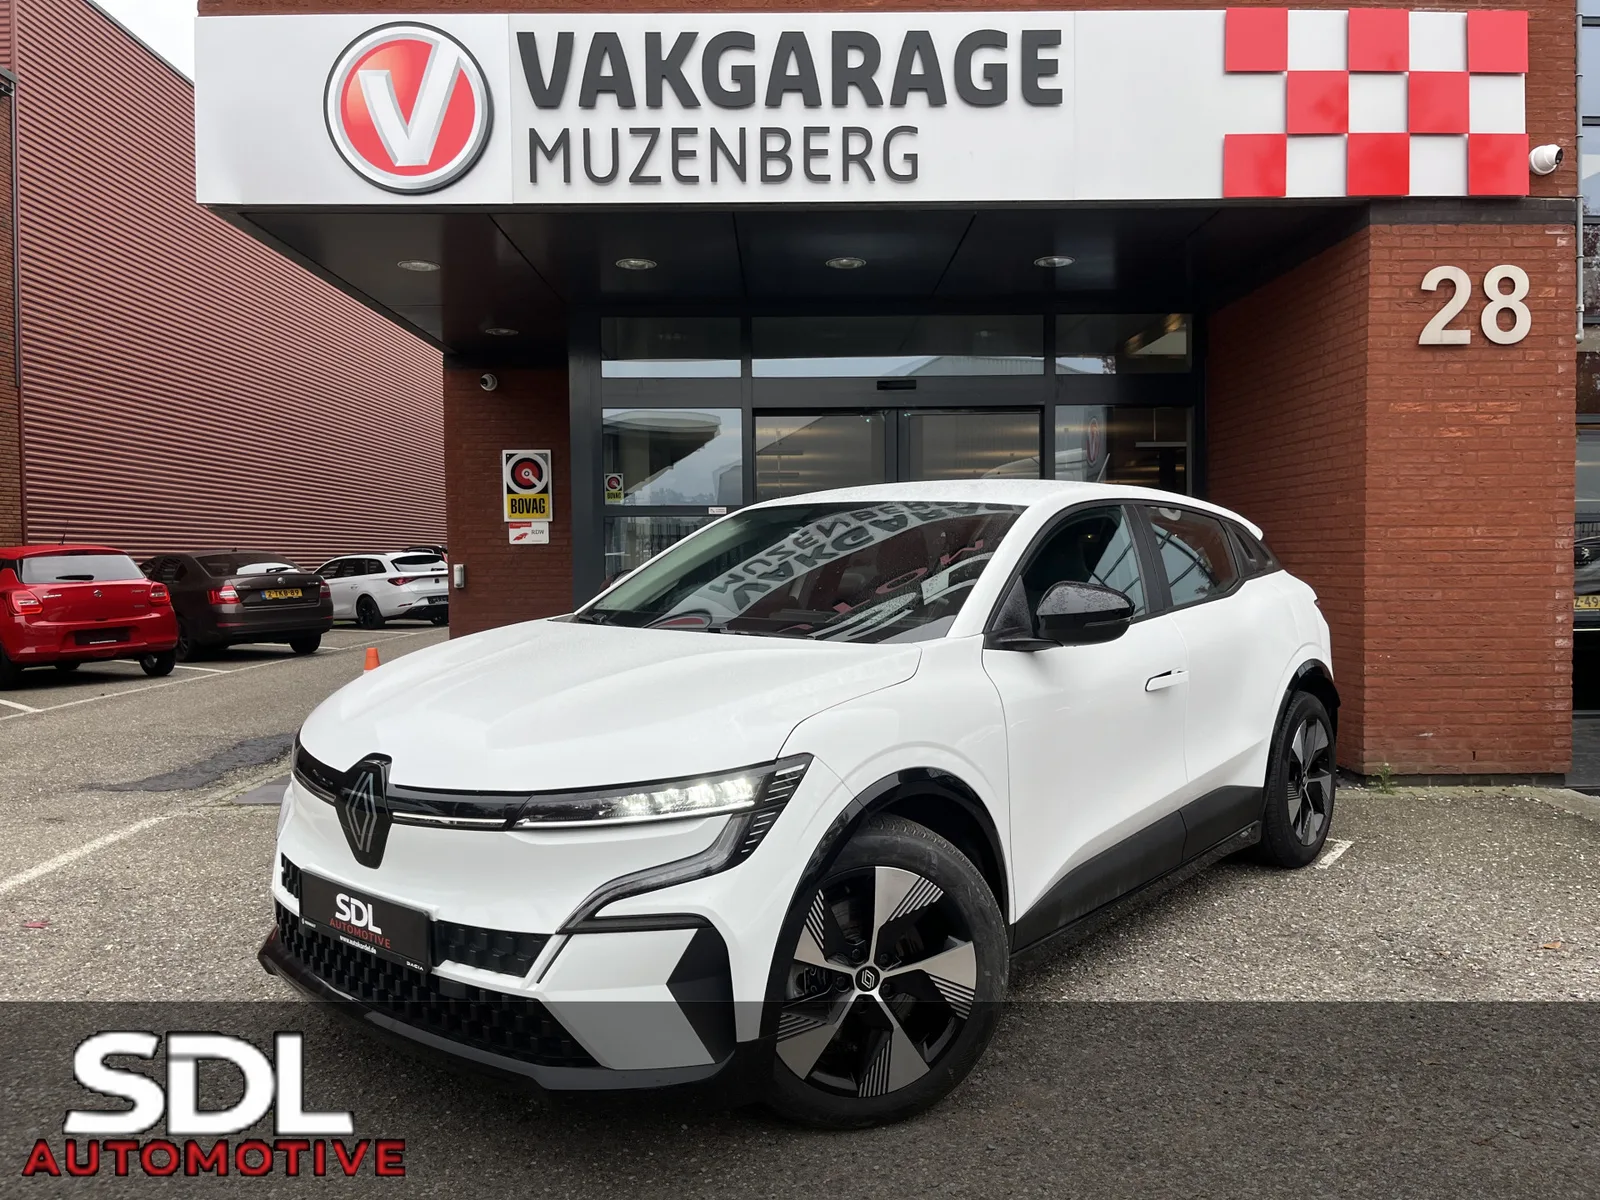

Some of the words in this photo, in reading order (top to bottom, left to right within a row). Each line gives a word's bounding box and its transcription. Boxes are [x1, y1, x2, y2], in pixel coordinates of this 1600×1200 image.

[516, 29, 1063, 109] VAKGARAGE
[529, 126, 920, 184] MUZENBERG
[1418, 264, 1532, 345] 28
[511, 497, 546, 514] BOVAG
[329, 917, 391, 949] AUTOMOTIVE
[335, 892, 382, 935] SDL
